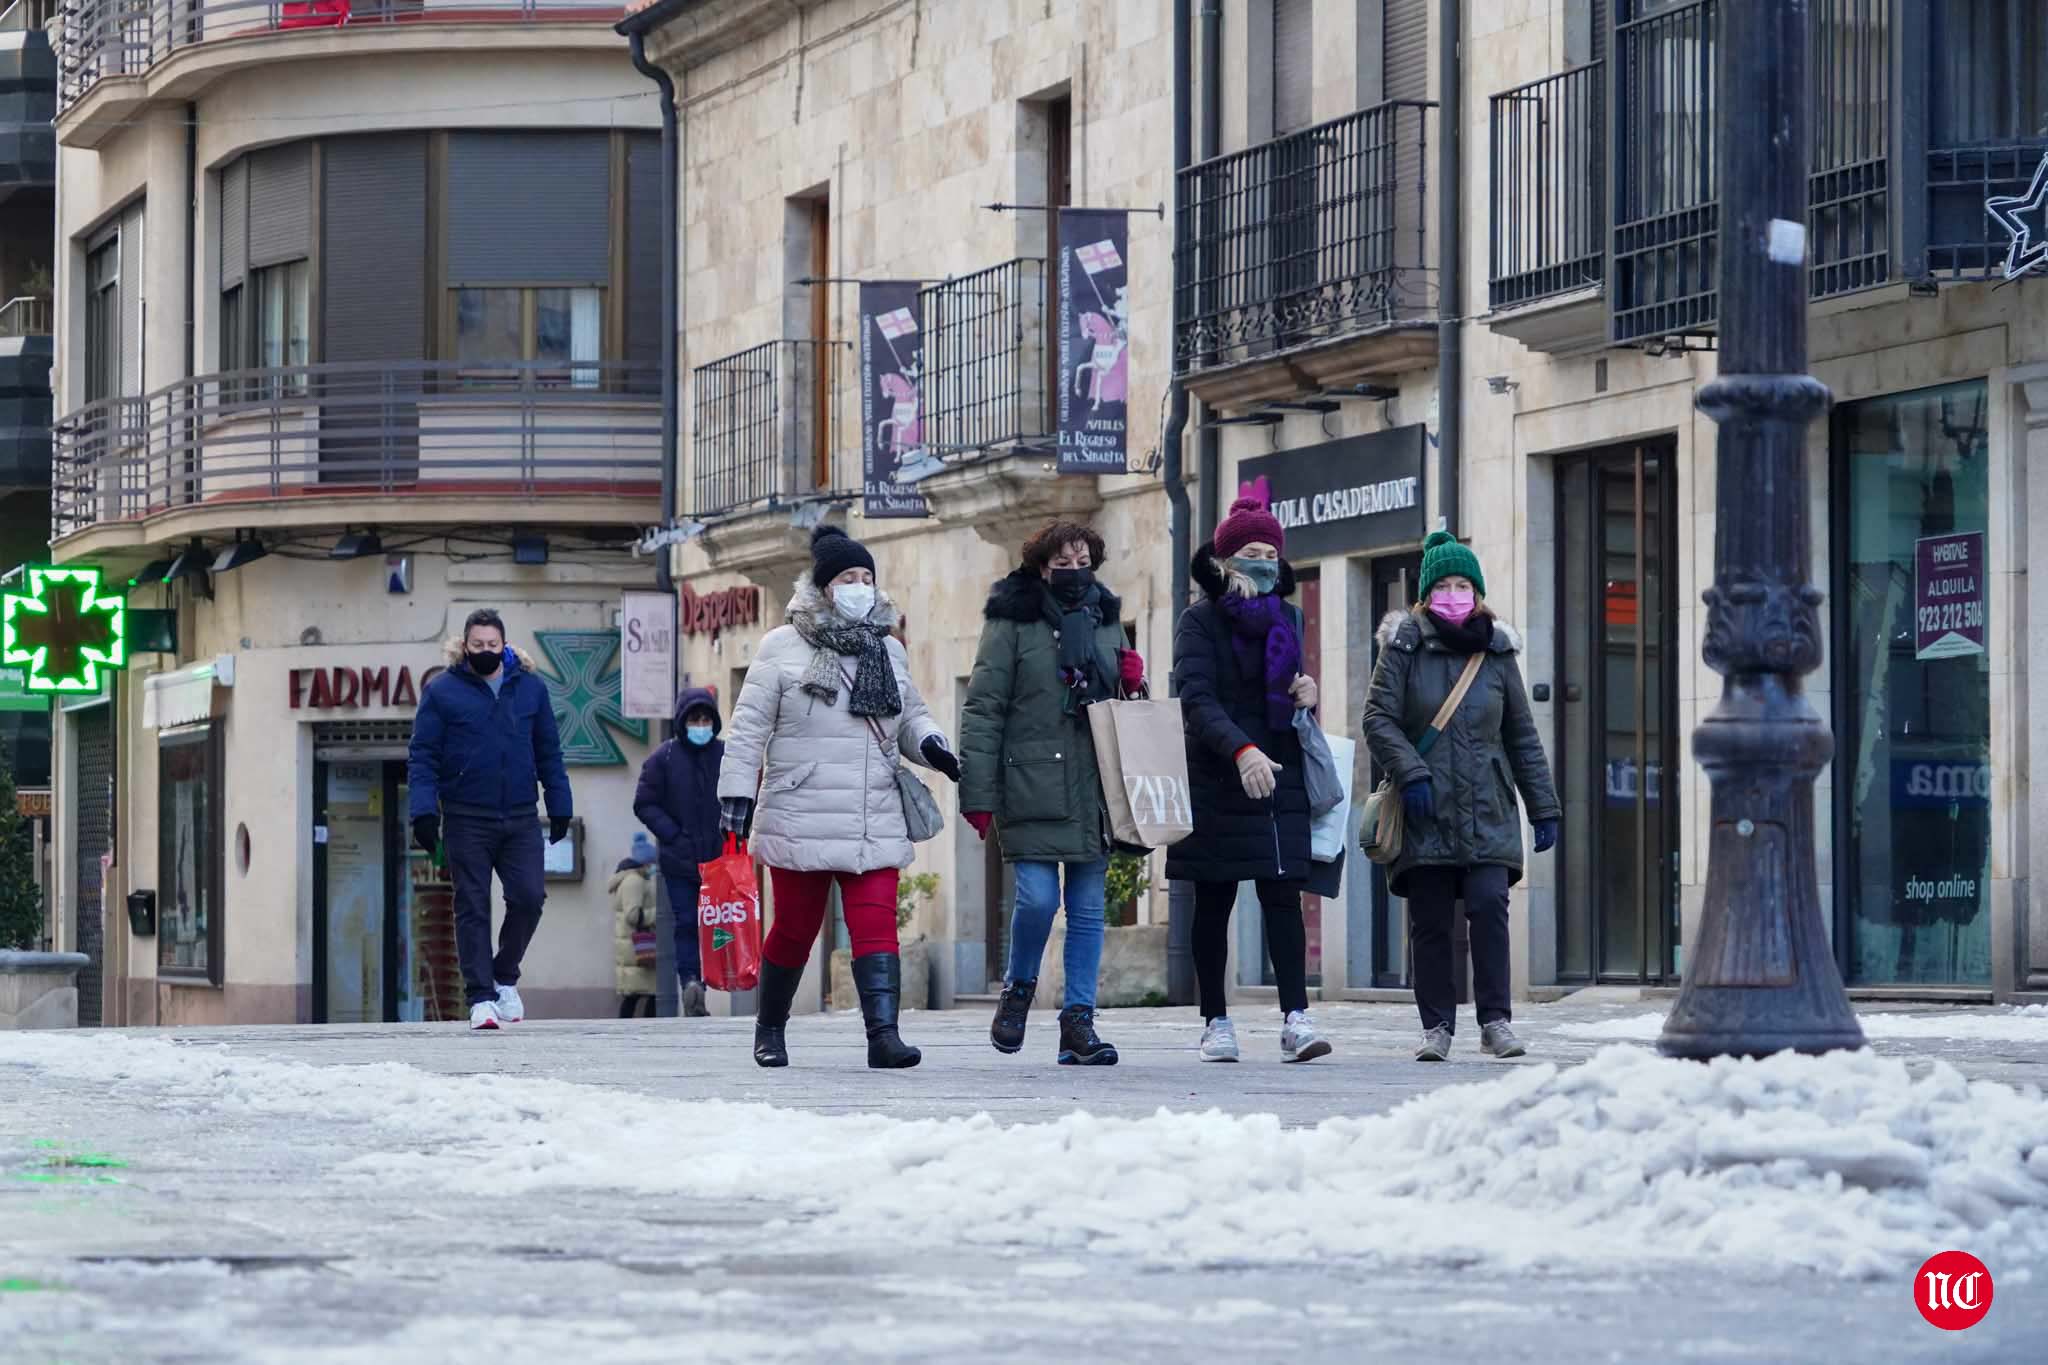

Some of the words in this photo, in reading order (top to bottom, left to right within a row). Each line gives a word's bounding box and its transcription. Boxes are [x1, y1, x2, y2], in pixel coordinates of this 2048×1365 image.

[1313, 476, 1417, 523] CASADEMUNT
[1928, 576, 1976, 596] ALQUILA
[1919, 606, 1941, 632] 923
[1942, 603, 1963, 630] 212
[1964, 600, 1983, 628] 506
[1905, 874, 1934, 904] shop
[1937, 873, 1975, 899] online
